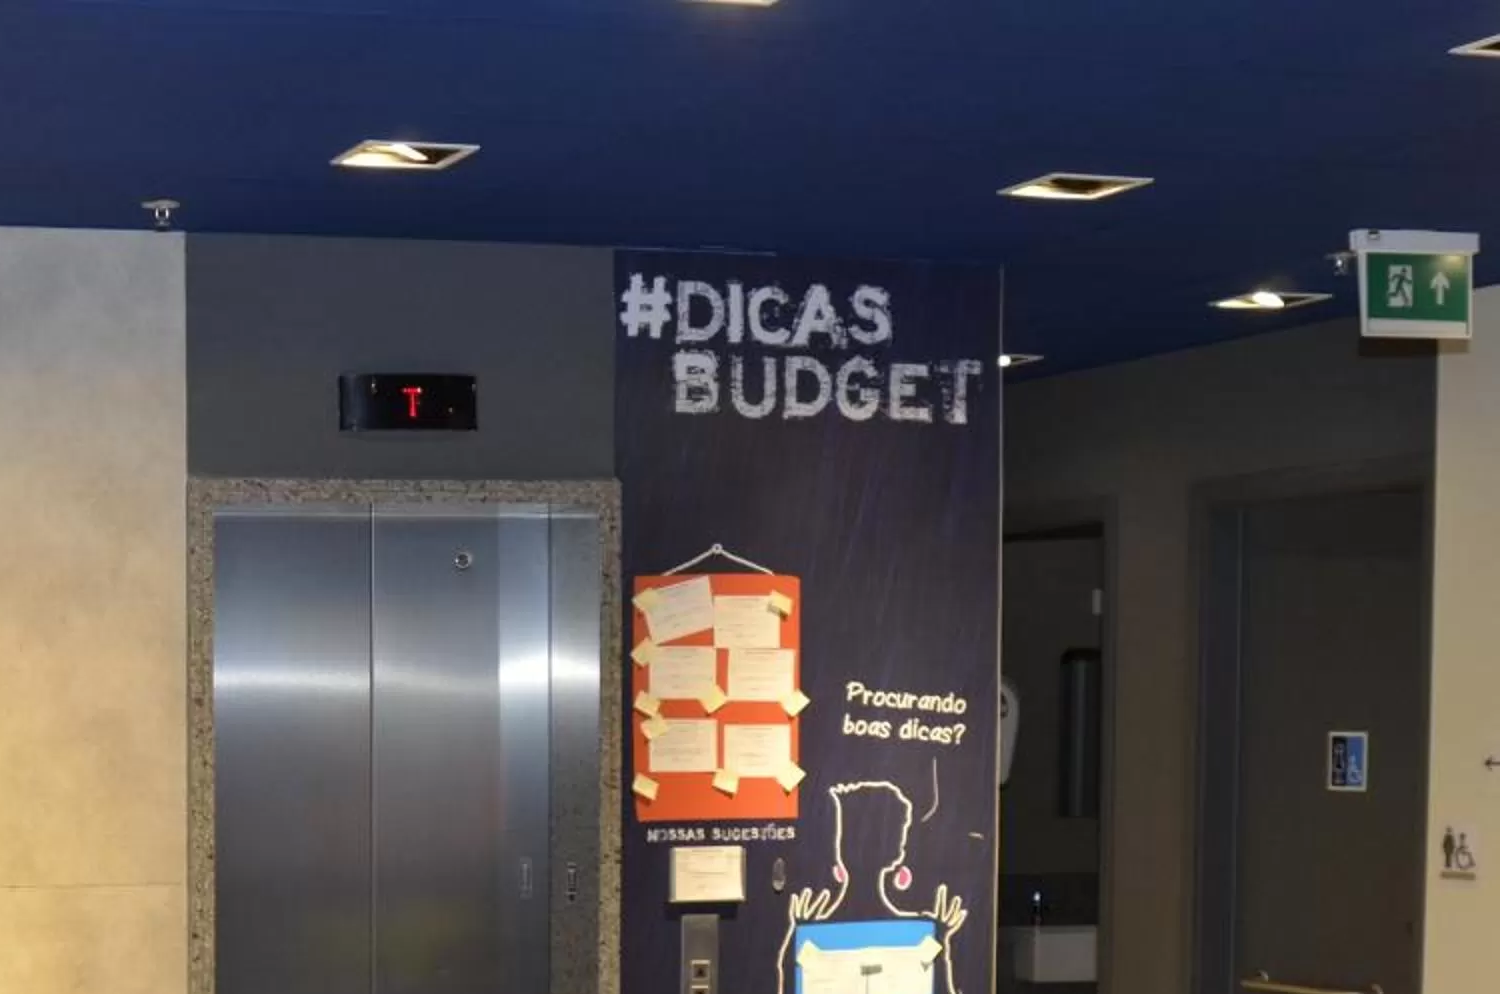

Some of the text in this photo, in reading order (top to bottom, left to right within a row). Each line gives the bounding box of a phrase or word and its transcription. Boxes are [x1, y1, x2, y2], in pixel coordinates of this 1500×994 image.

[619, 272, 894, 348] #DICAS
[402, 387, 422, 417] T
[672, 349, 983, 425] BUDGET
[846, 681, 967, 714] Procurando
[843, 713, 967, 744] boas dicas?
[647, 827, 706, 842] NOSSAS
